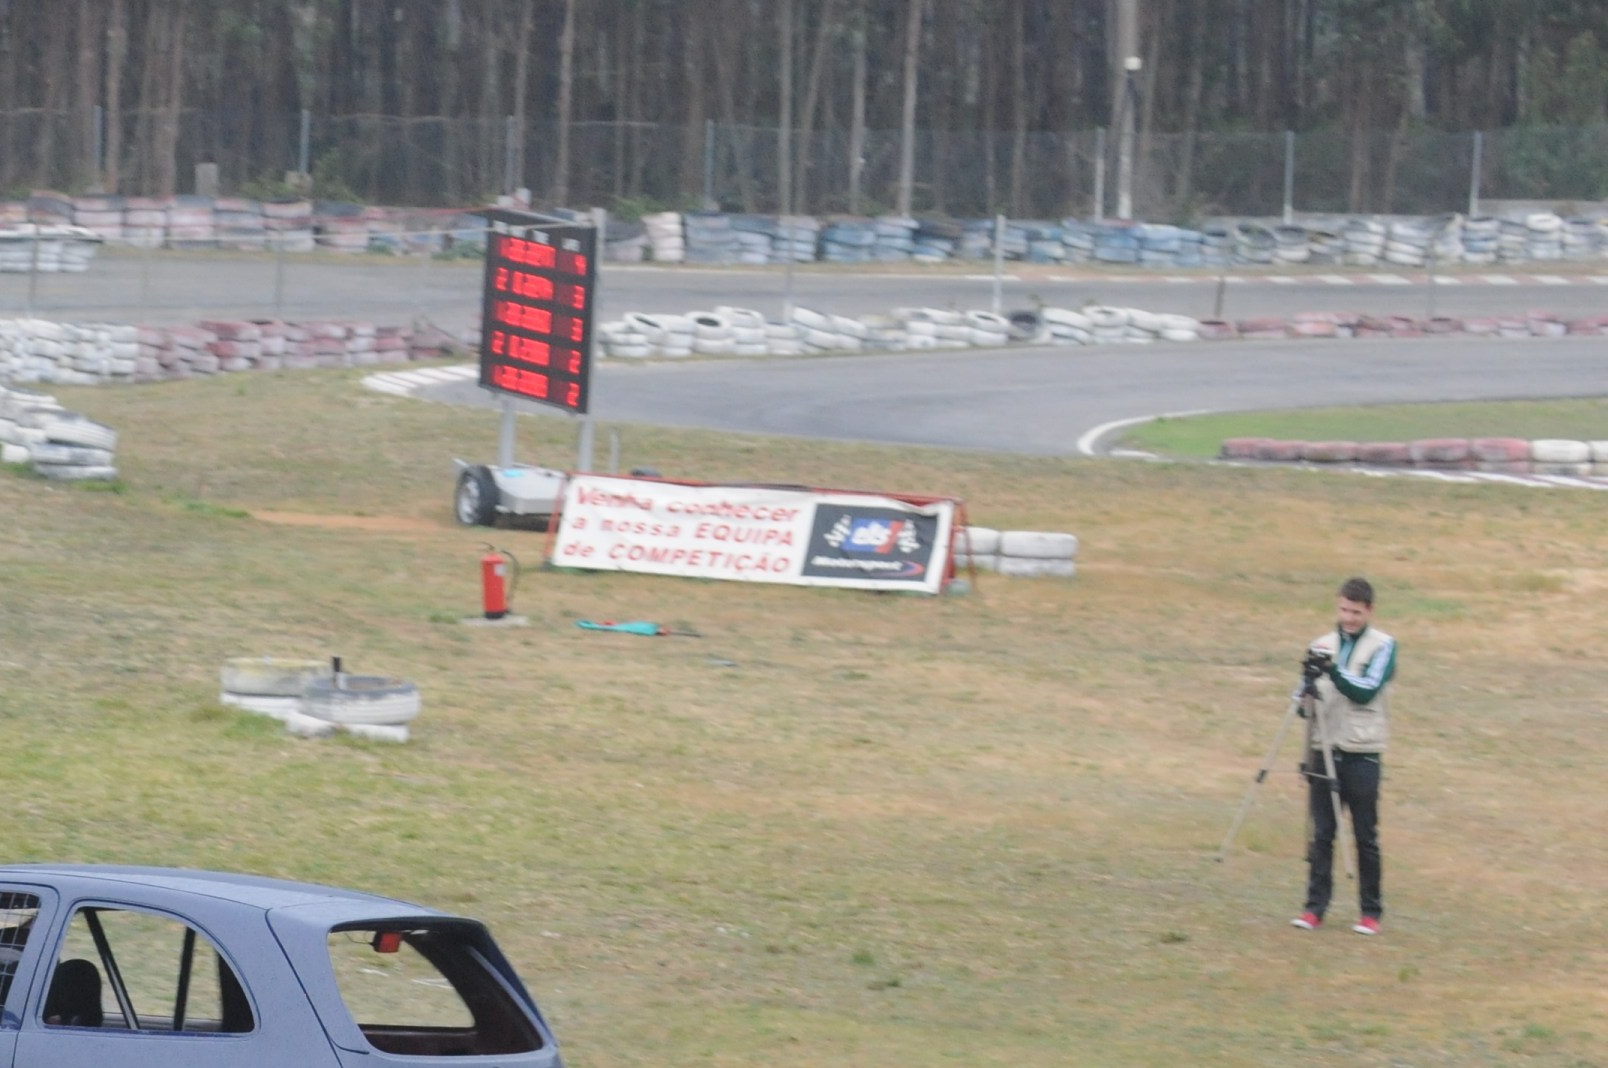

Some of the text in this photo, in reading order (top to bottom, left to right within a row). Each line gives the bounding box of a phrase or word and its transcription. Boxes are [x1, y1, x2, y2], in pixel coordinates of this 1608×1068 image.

[569, 349, 582, 375] 2
[567, 382, 580, 408] 2
[577, 486, 802, 522] Venha conhecer
[571, 516, 795, 547] a nossa EQUIPA
[563, 540, 792, 574] de COMPETIÇÃO
